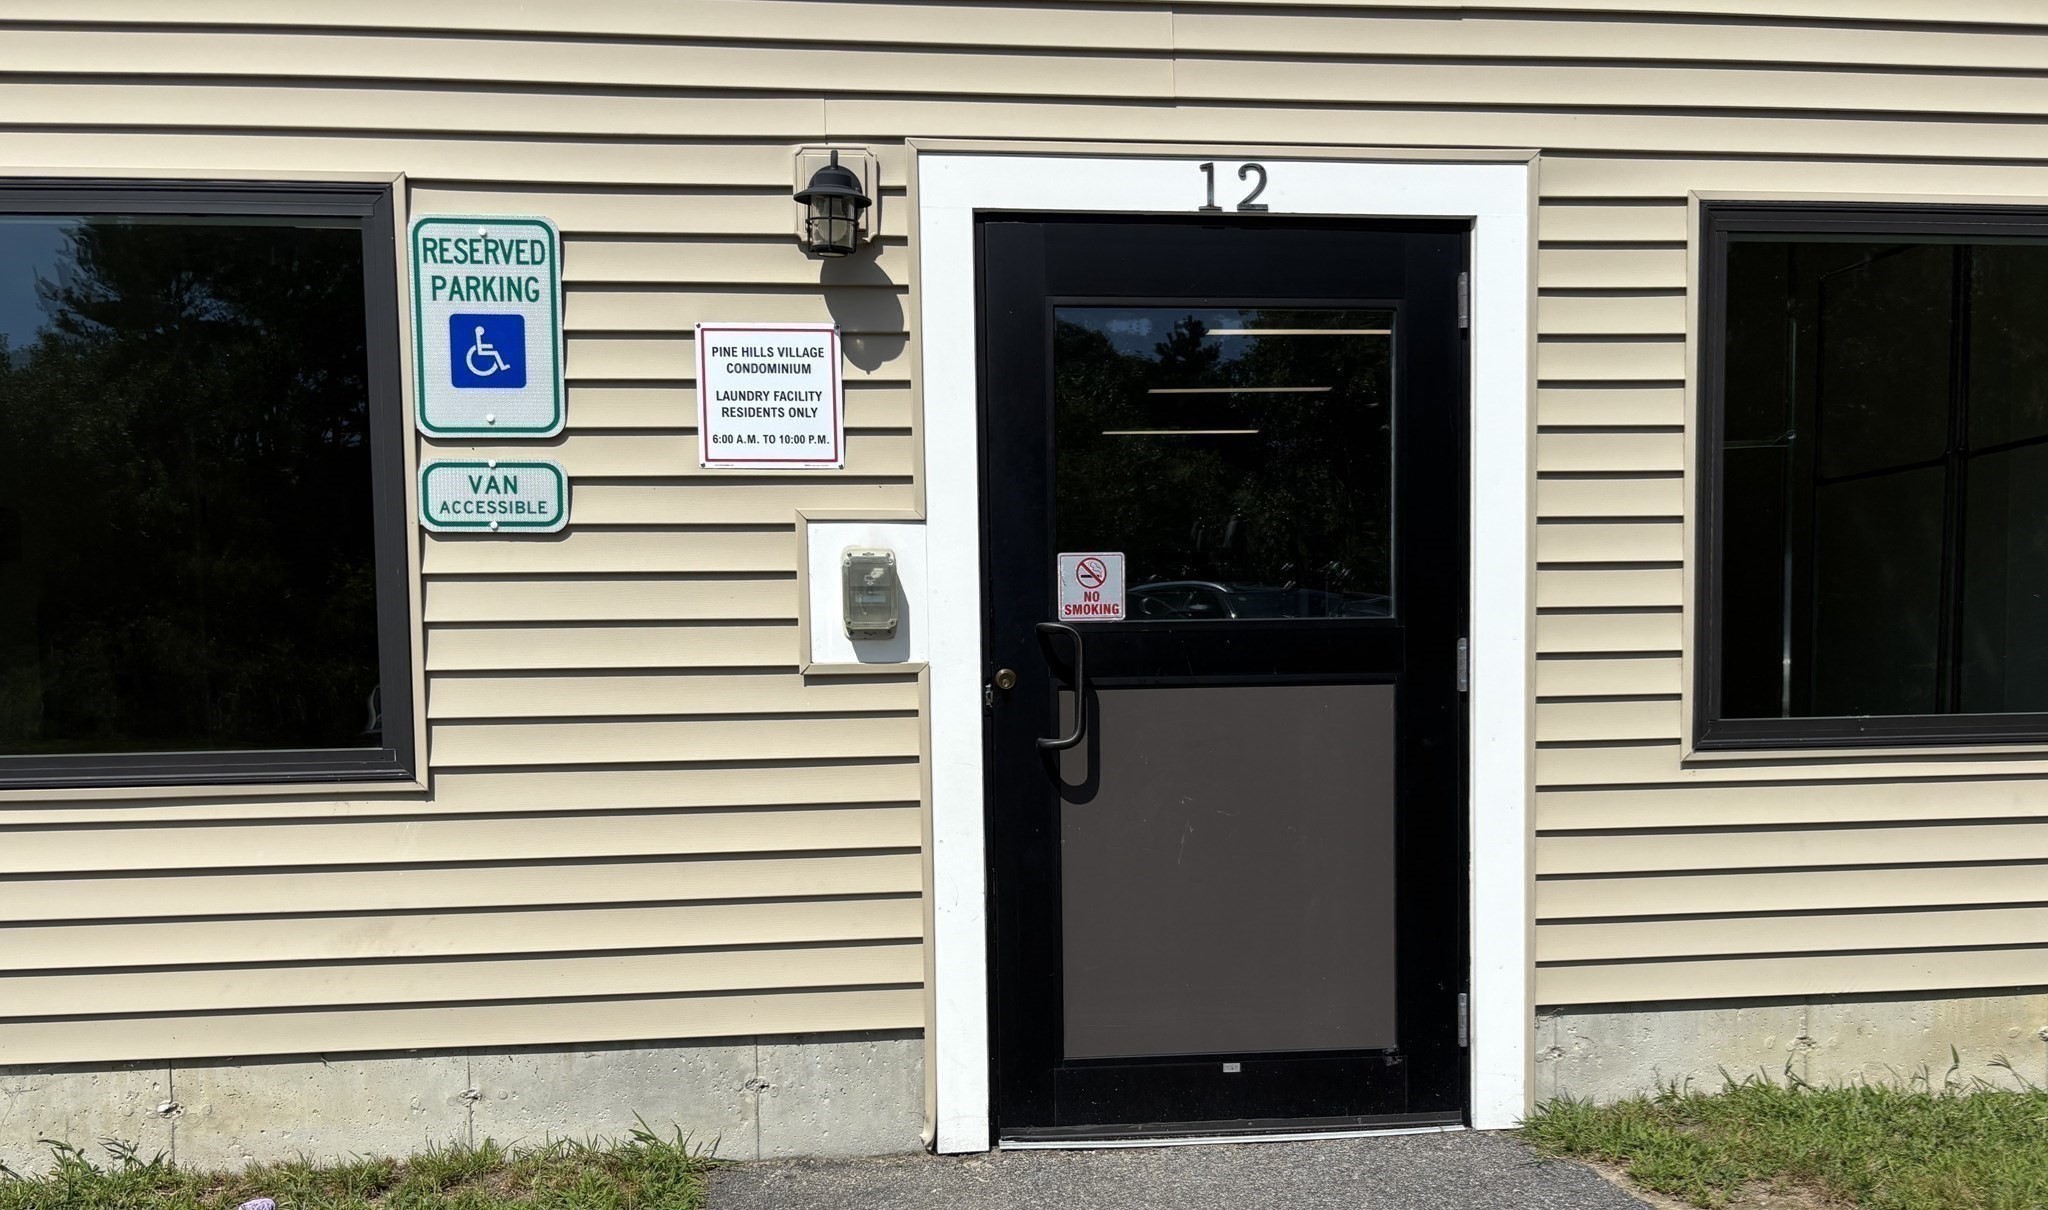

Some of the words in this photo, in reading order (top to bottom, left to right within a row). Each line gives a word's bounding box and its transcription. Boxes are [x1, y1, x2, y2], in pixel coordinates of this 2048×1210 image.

[1199, 162, 1268, 212] 12
[423, 238, 545, 265] RESERVED
[432, 276, 540, 303] PARKING
[712, 346, 738, 357] PINE
[742, 347, 774, 357] HILLS
[777, 347, 824, 358] VILLAGE
[726, 363, 811, 374] CONDOMINIUM
[716, 391, 769, 401] LAUNDRY
[774, 391, 822, 401] FACILITY
[722, 407, 784, 418] RESIDENTS
[788, 407, 817, 418] ONLY
[712, 434, 733, 444] 6:00
[736, 434, 760, 444] A.M.
[763, 435, 775, 444] TO
[779, 435, 805, 444] 10:00
[808, 435, 830, 444] P.M.
[468, 475, 518, 495] VAN
[440, 501, 547, 515] ACCESSIBLE
[1084, 591, 1100, 602] NO
[1064, 604, 1119, 615] SMOKING
